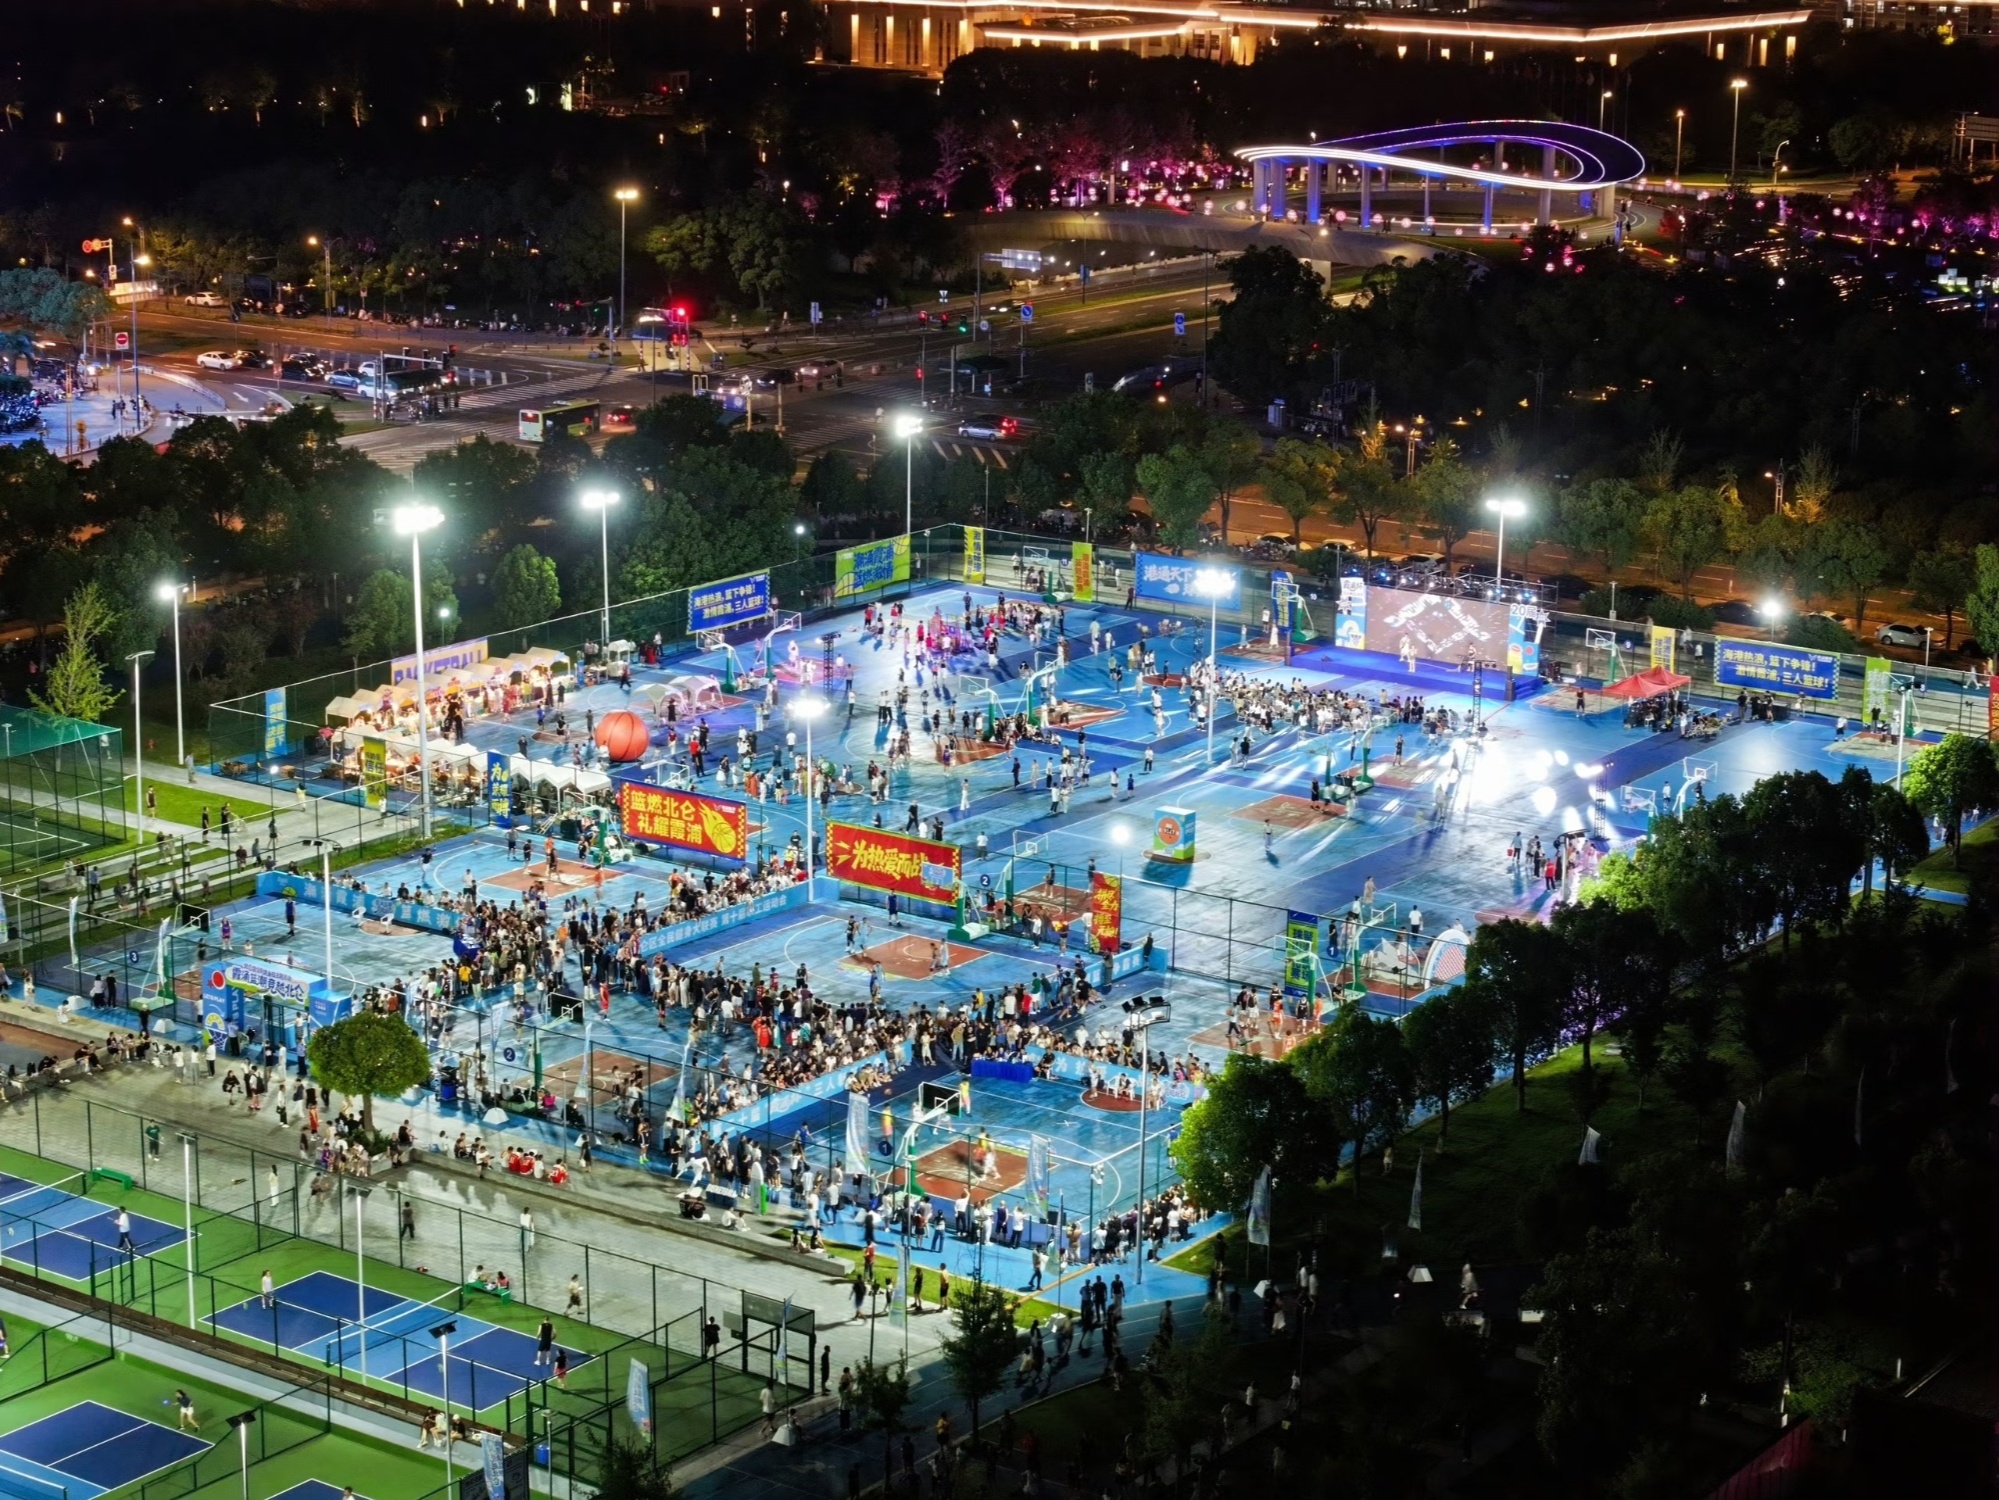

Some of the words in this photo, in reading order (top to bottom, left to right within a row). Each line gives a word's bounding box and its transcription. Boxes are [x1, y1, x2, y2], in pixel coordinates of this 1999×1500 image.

[851, 839, 929, 881] 为热爱而战
[982, 876, 988, 885] 2
[506, 1049, 512, 1059] 2
